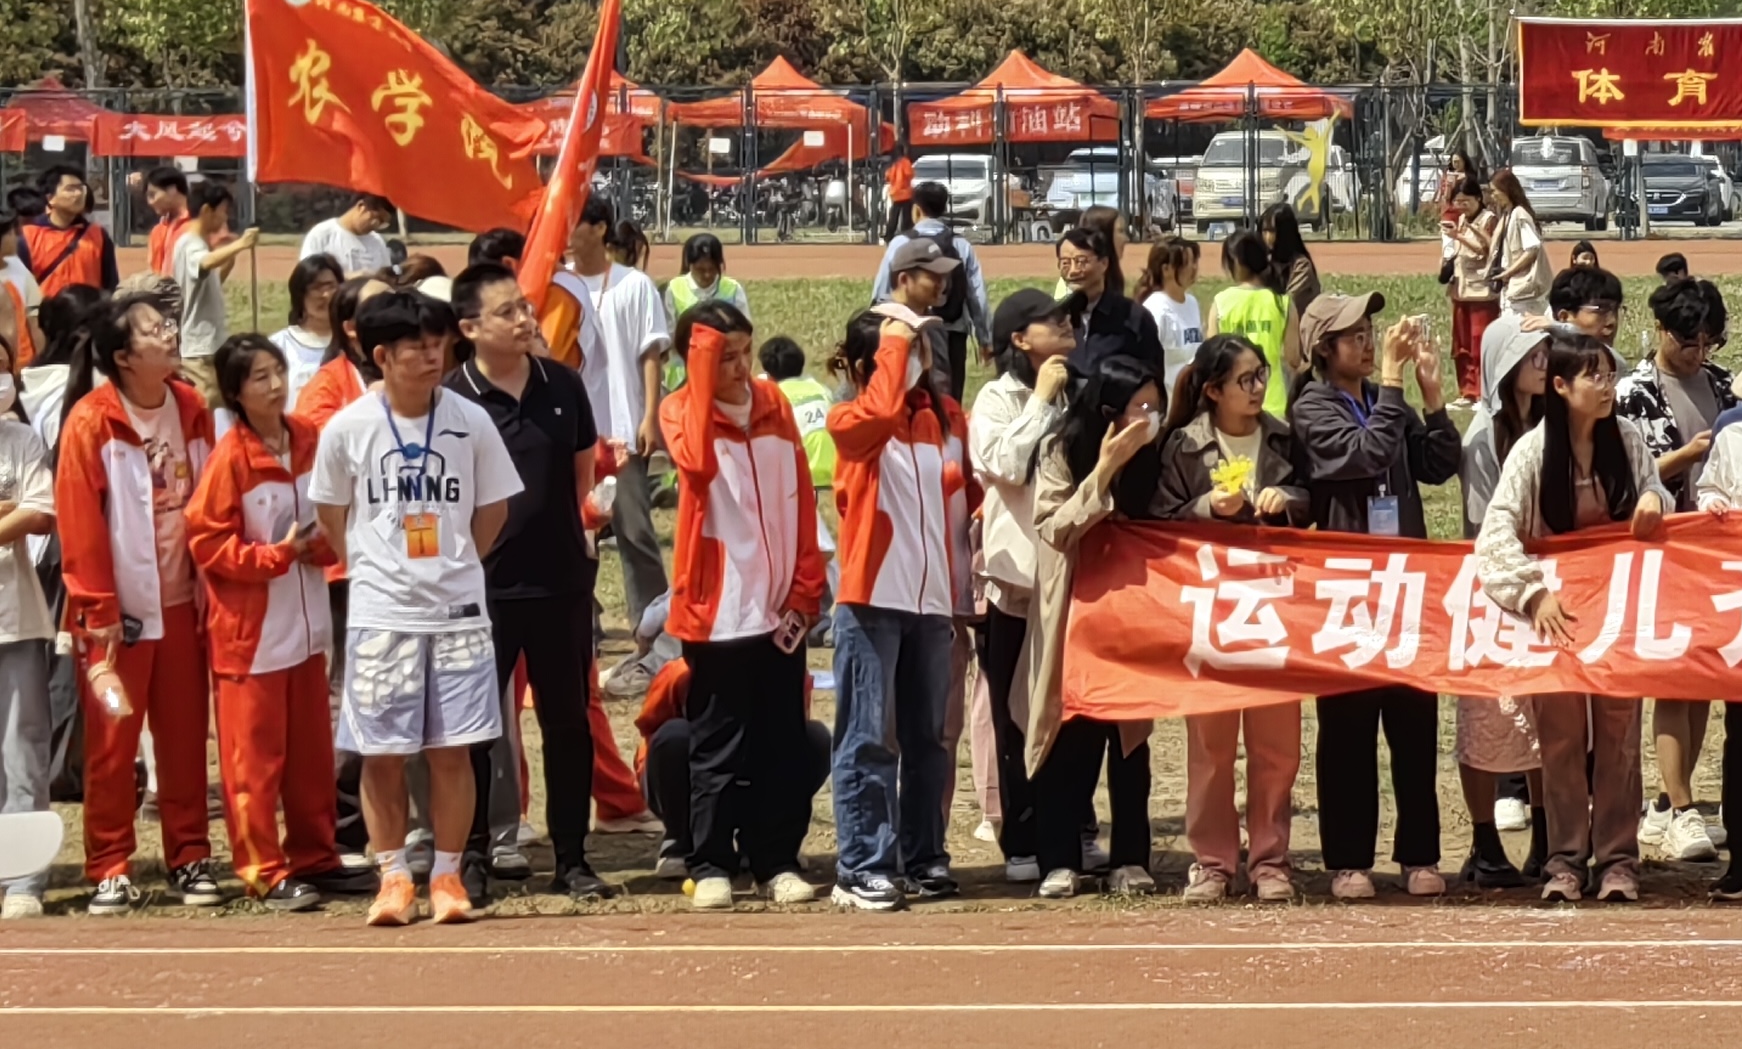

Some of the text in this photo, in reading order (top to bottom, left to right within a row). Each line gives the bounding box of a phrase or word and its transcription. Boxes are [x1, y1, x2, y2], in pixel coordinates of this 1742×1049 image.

[922, 103, 1082, 139] 动科油站
[367, 474, 460, 504] LI-NNG
